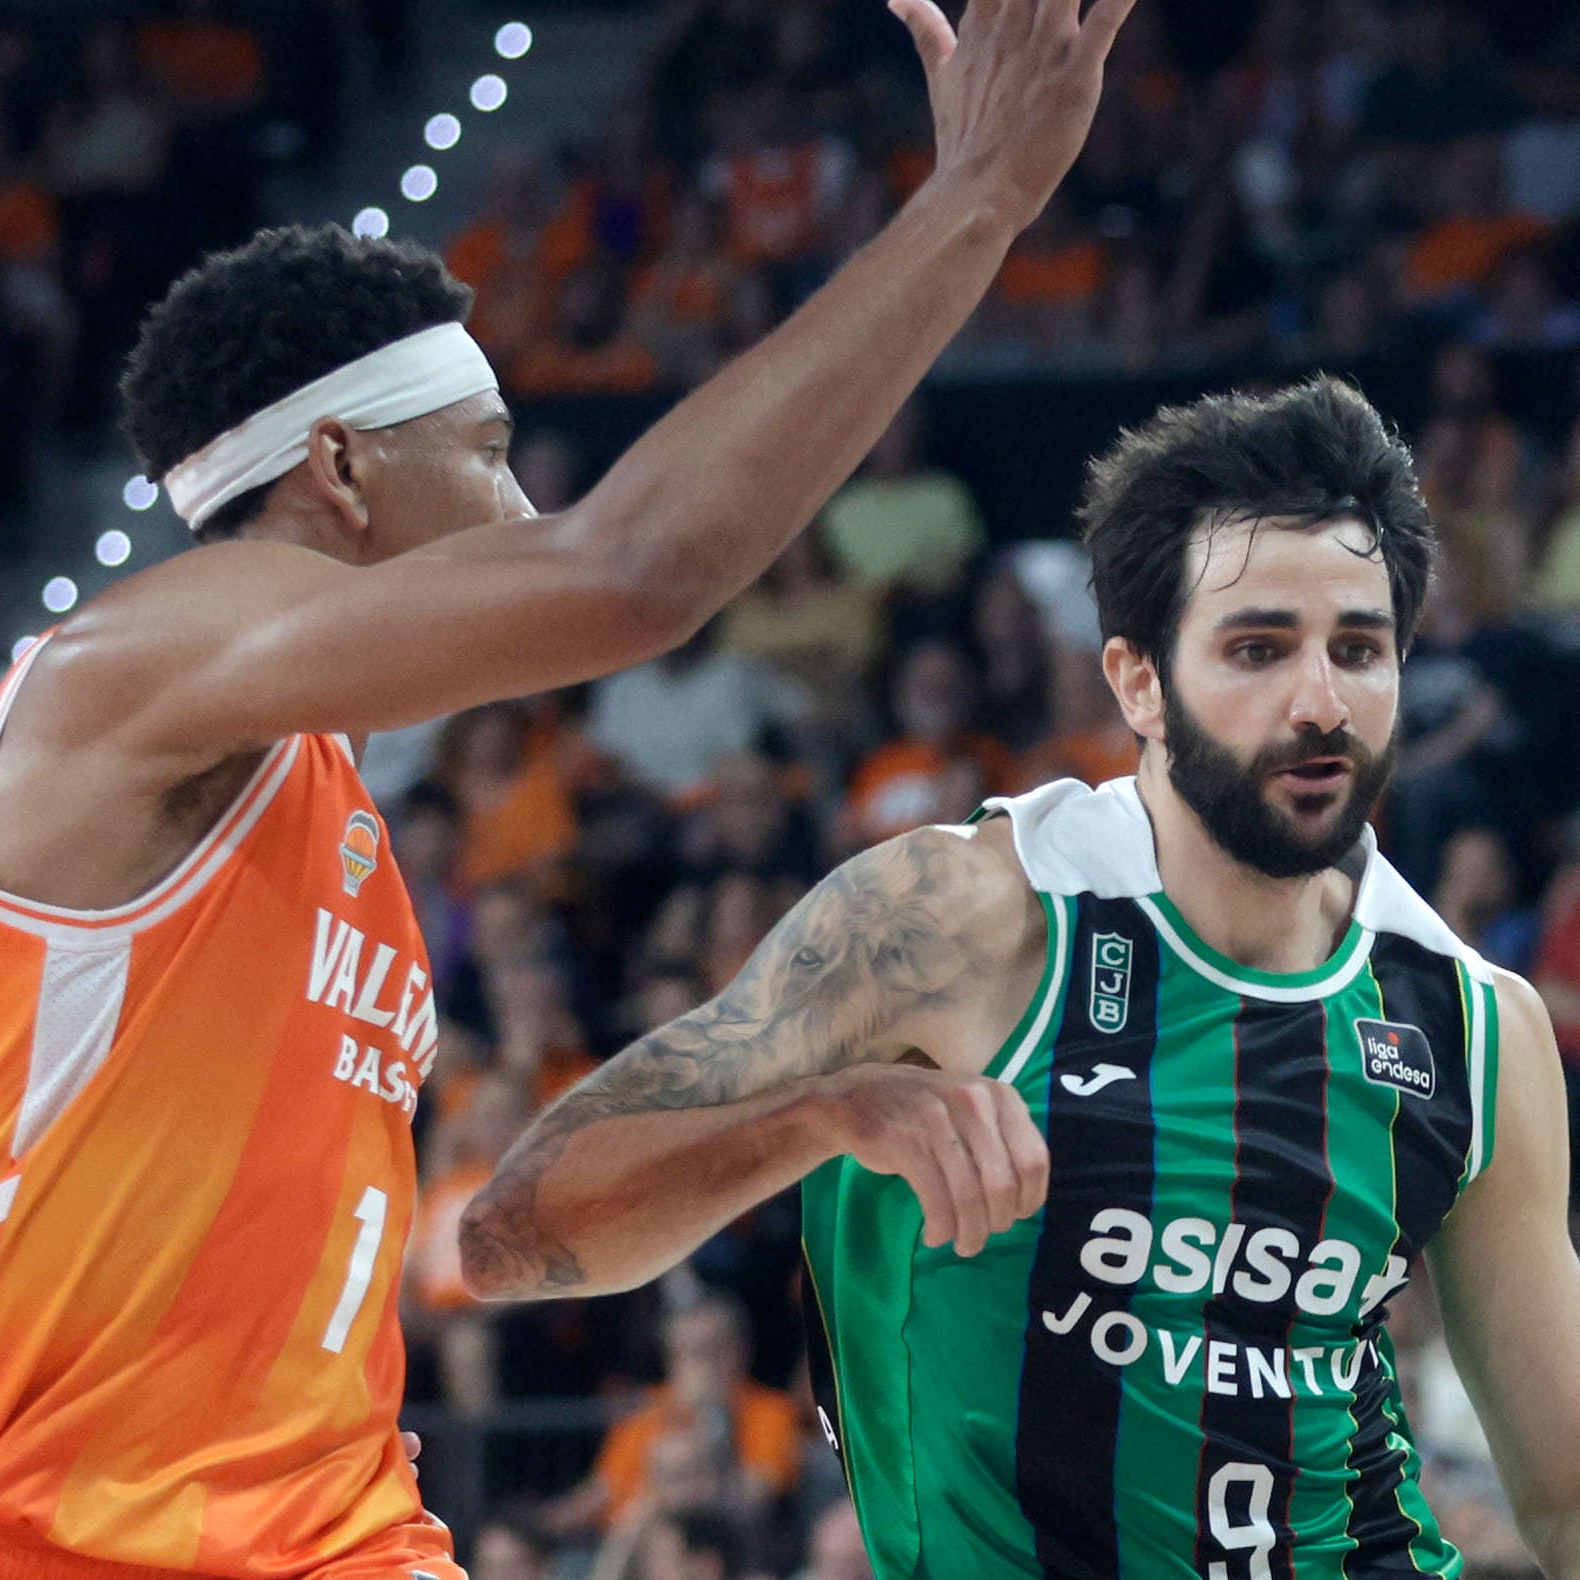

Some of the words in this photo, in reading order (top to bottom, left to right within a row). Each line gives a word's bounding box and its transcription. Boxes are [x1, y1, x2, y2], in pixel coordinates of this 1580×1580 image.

[306, 907, 438, 1080] VALEN
[1368, 1037, 1399, 1061] liga
[1371, 1058, 1430, 1090] endesa
[321, 1185, 387, 1355] 1
[1042, 1291, 1379, 1399] JOVENTU
